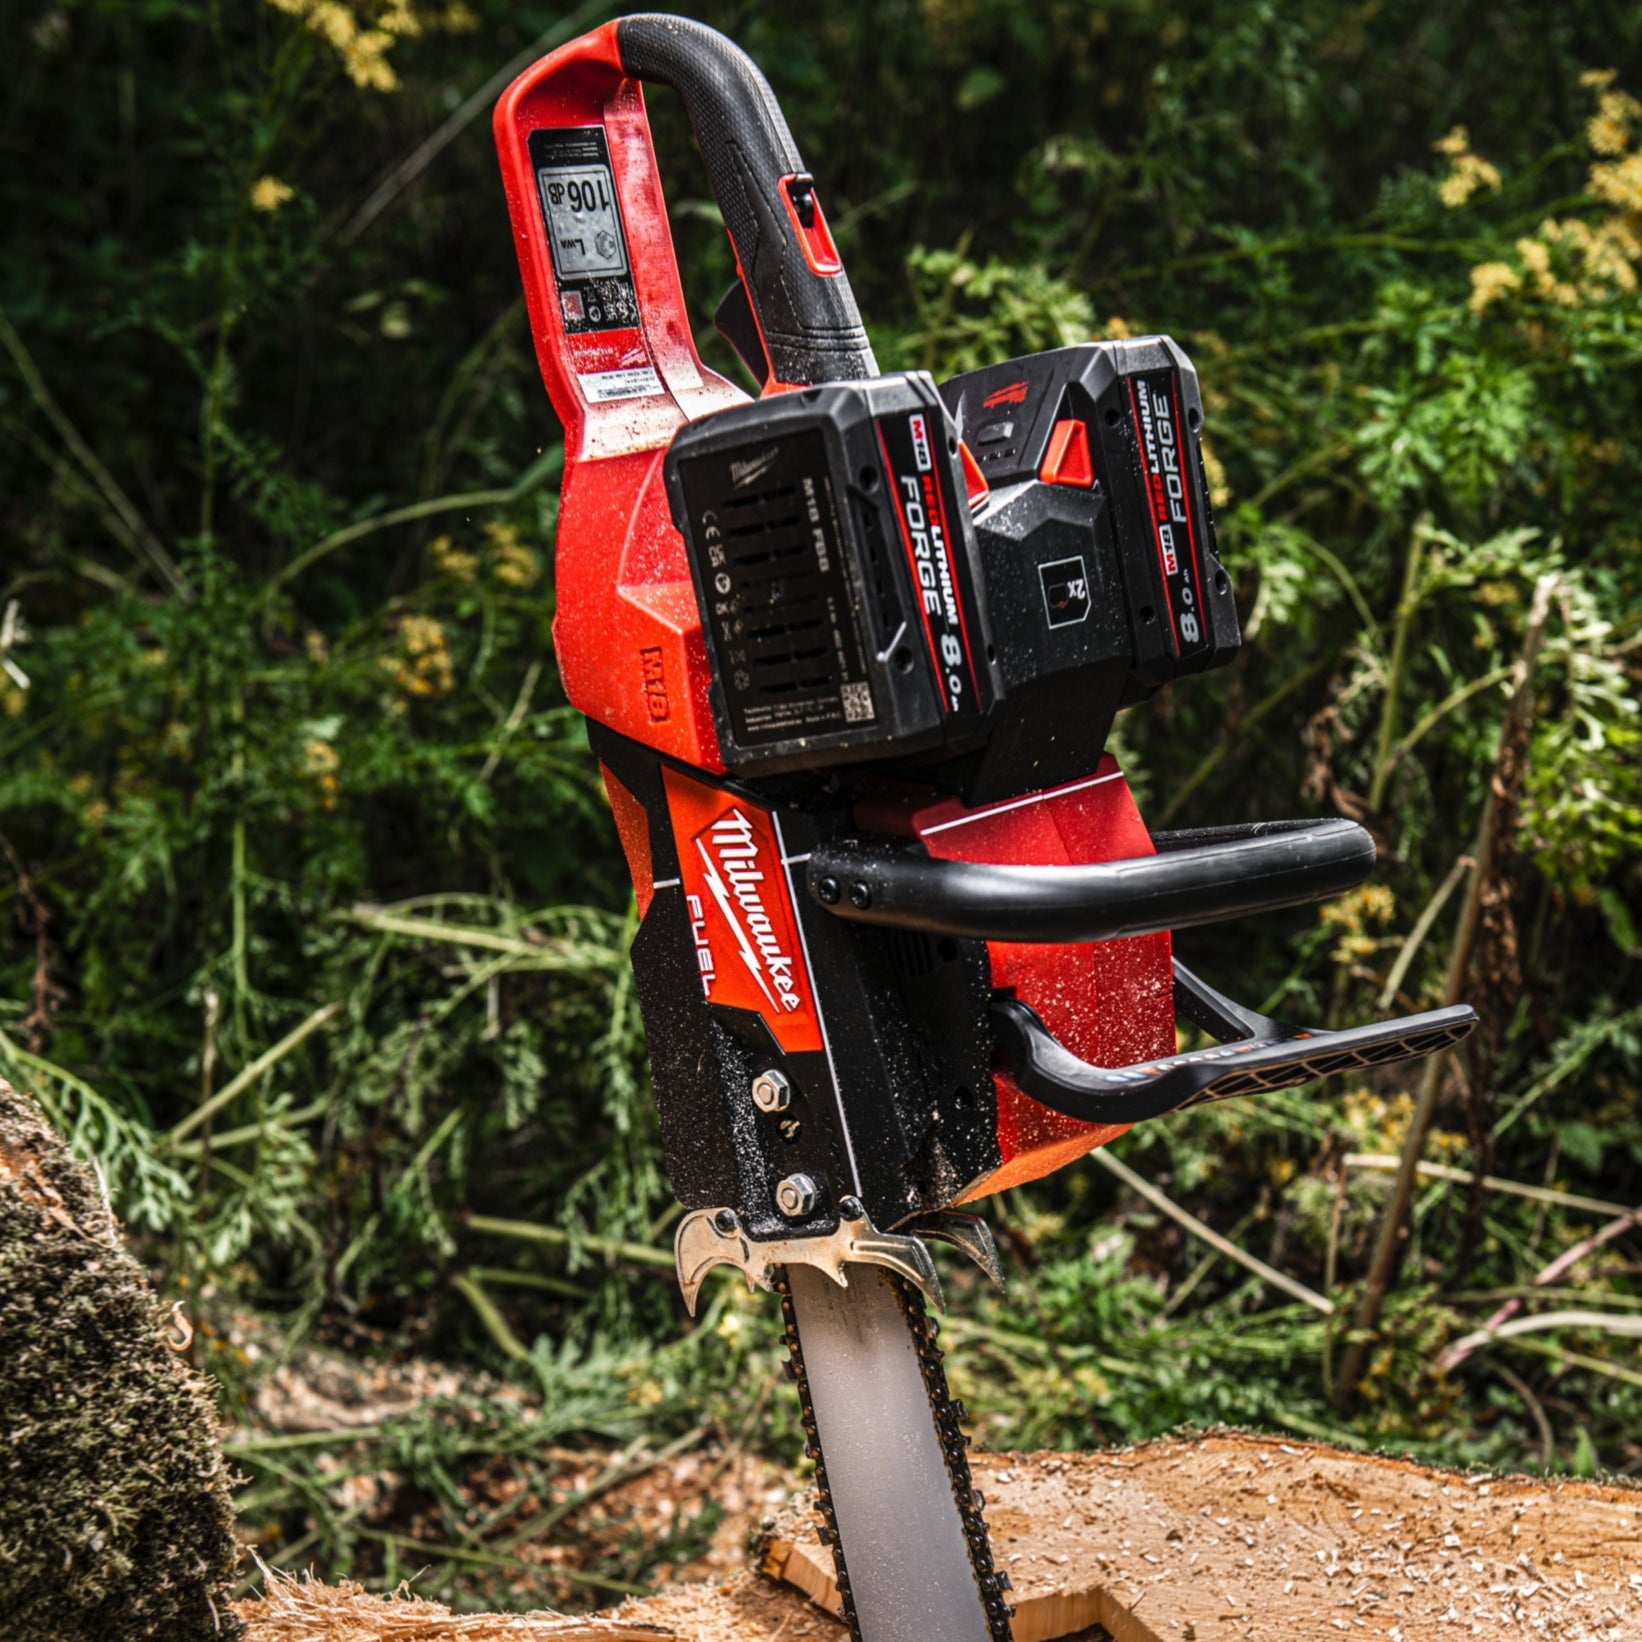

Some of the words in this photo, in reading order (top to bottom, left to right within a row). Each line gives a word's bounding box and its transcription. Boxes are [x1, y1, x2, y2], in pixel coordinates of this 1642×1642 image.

[548, 183, 565, 204] dB
[568, 180, 610, 212] 106
[911, 418, 931, 470] M18
[1154, 395, 1186, 523] FORGE
[802, 477, 819, 525] M18
[901, 475, 942, 616] FORGE
[1160, 527, 1178, 573] M18
[1068, 578, 1086, 600] 2x
[1180, 588, 1200, 643] 8.0
[643, 651, 668, 719] M18
[940, 634, 962, 696] 8.0
[711, 808, 800, 1013] Milwaukee
[686, 894, 716, 996] FUEL
